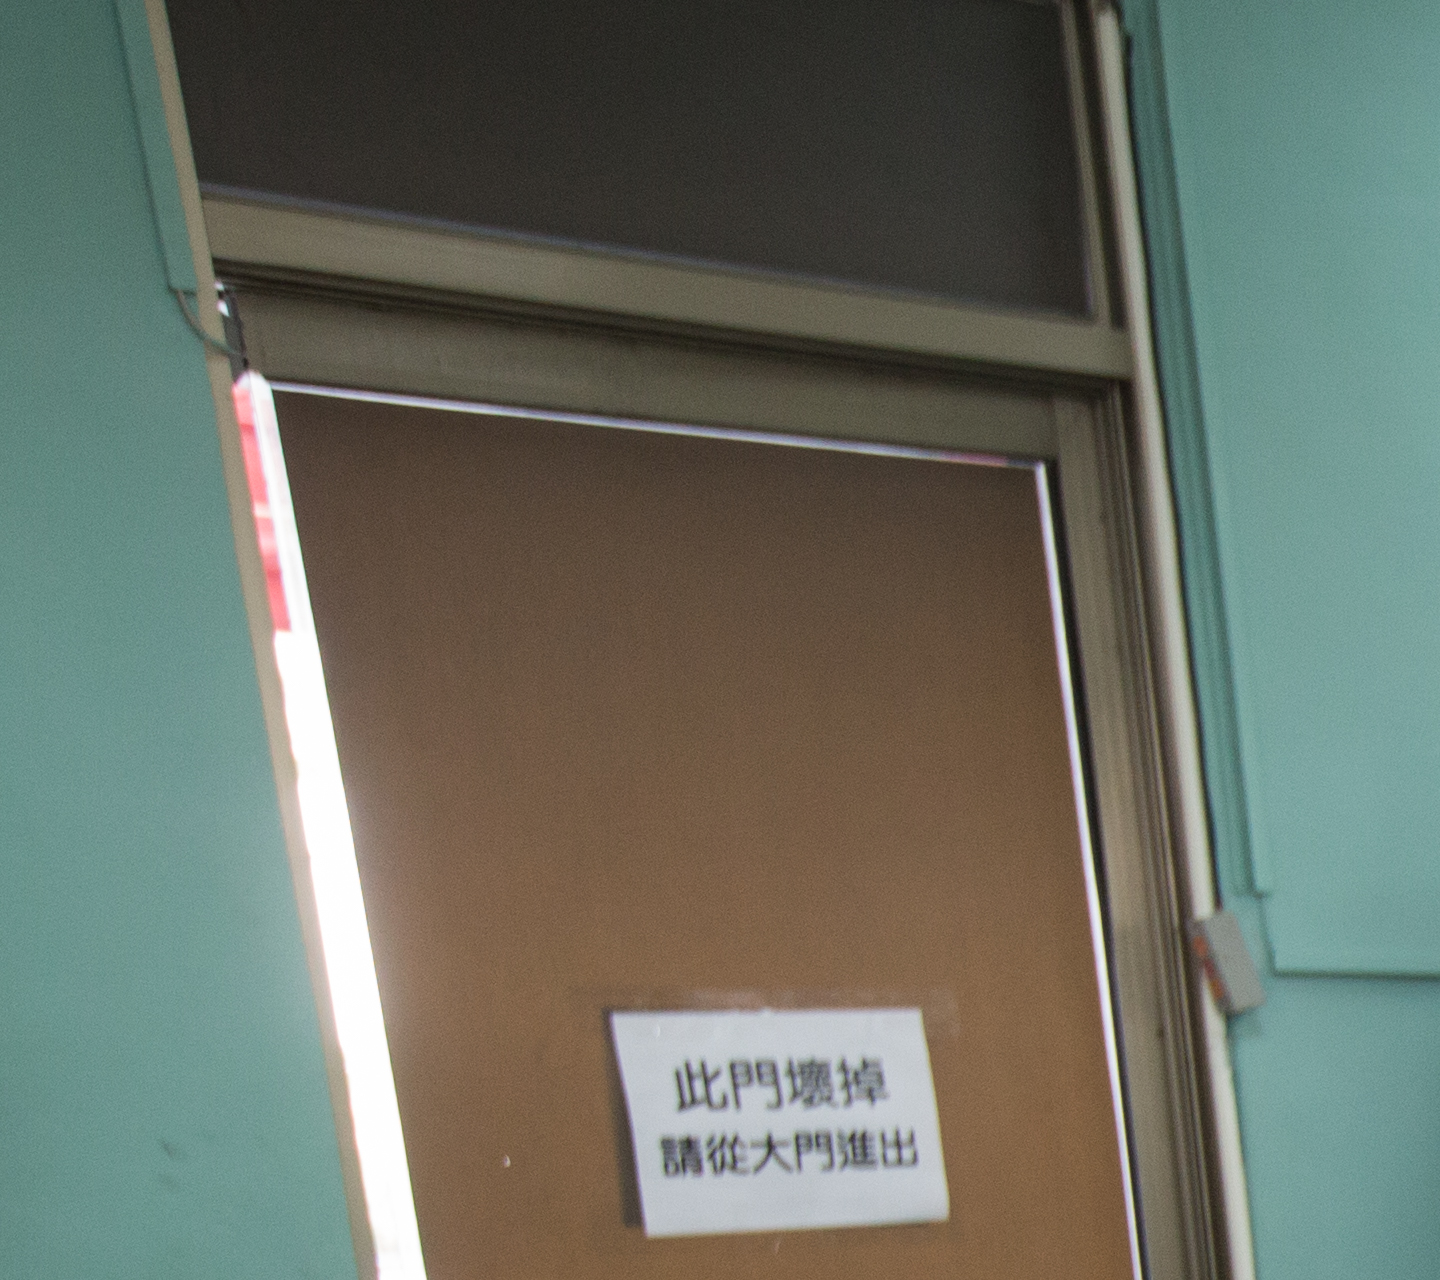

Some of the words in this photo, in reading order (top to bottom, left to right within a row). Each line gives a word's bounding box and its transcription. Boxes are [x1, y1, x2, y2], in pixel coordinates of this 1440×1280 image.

[674, 1056, 890, 1113] 此門壞掉
[659, 1128, 919, 1178] 請從大門進出
